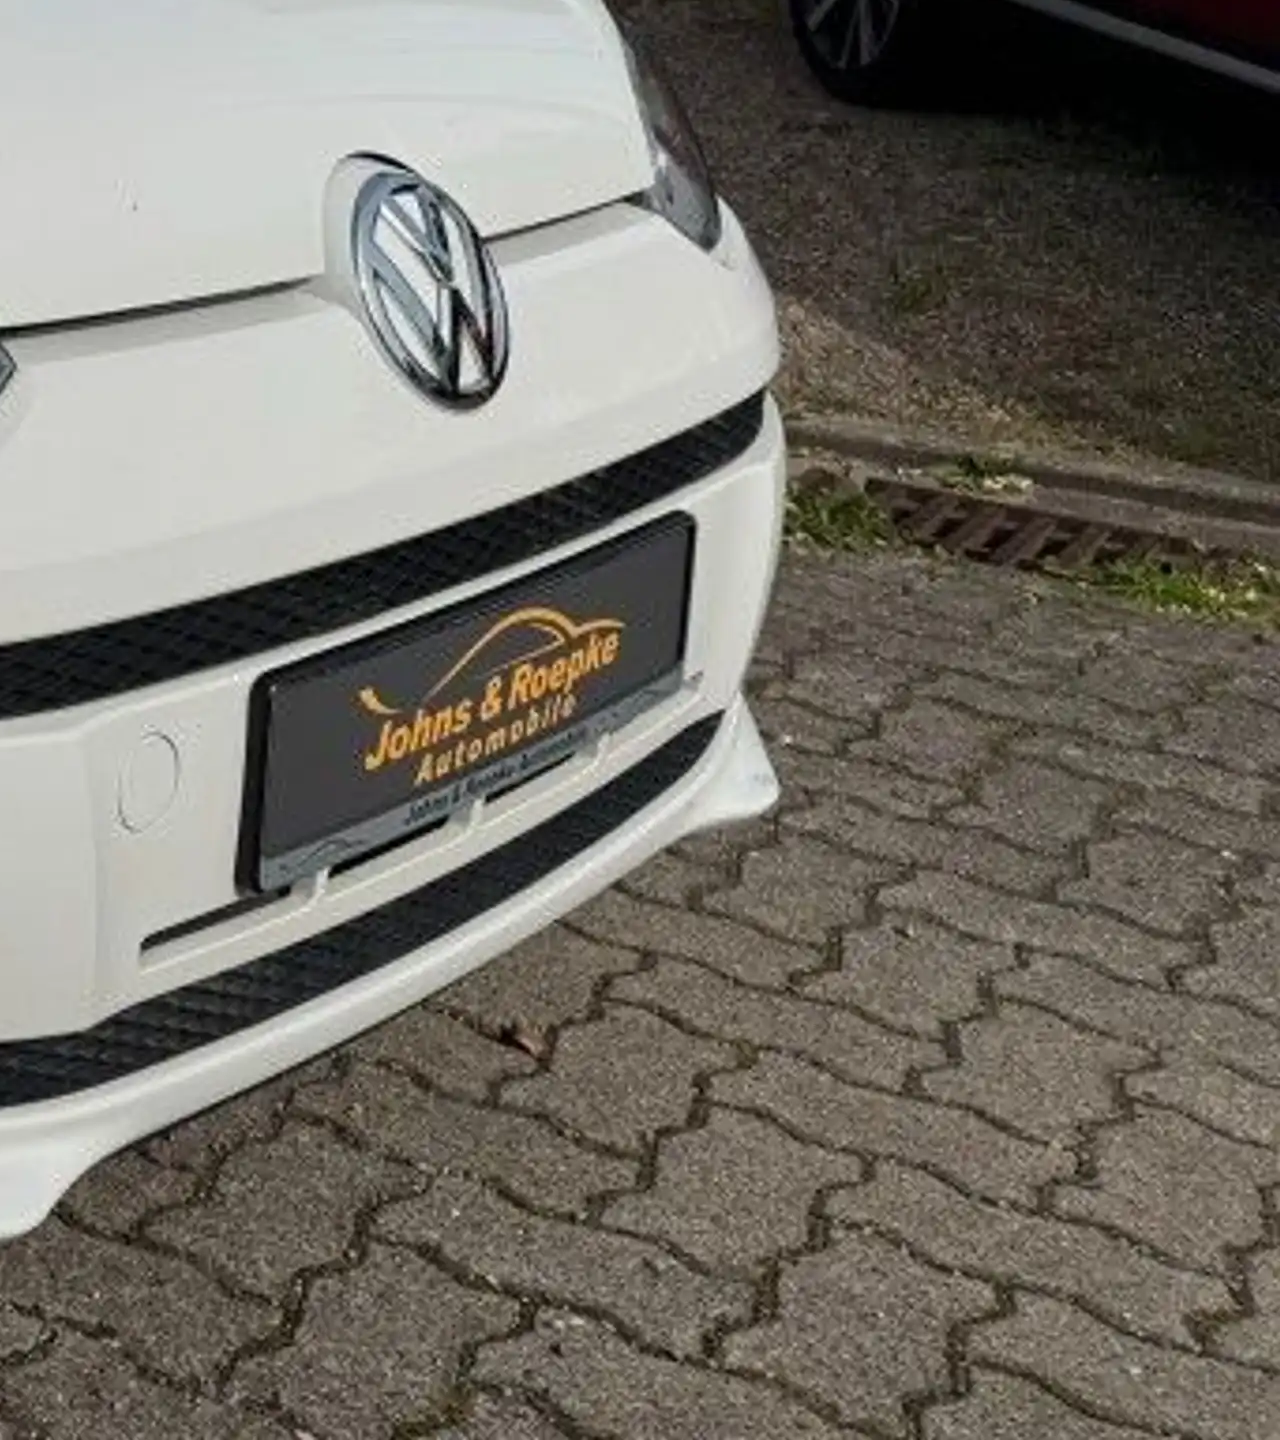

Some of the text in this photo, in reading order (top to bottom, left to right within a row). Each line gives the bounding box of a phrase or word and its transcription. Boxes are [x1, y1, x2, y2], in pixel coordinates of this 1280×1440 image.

[364, 630, 621, 771] Johns & Roepke
[413, 694, 578, 787] Automobile
